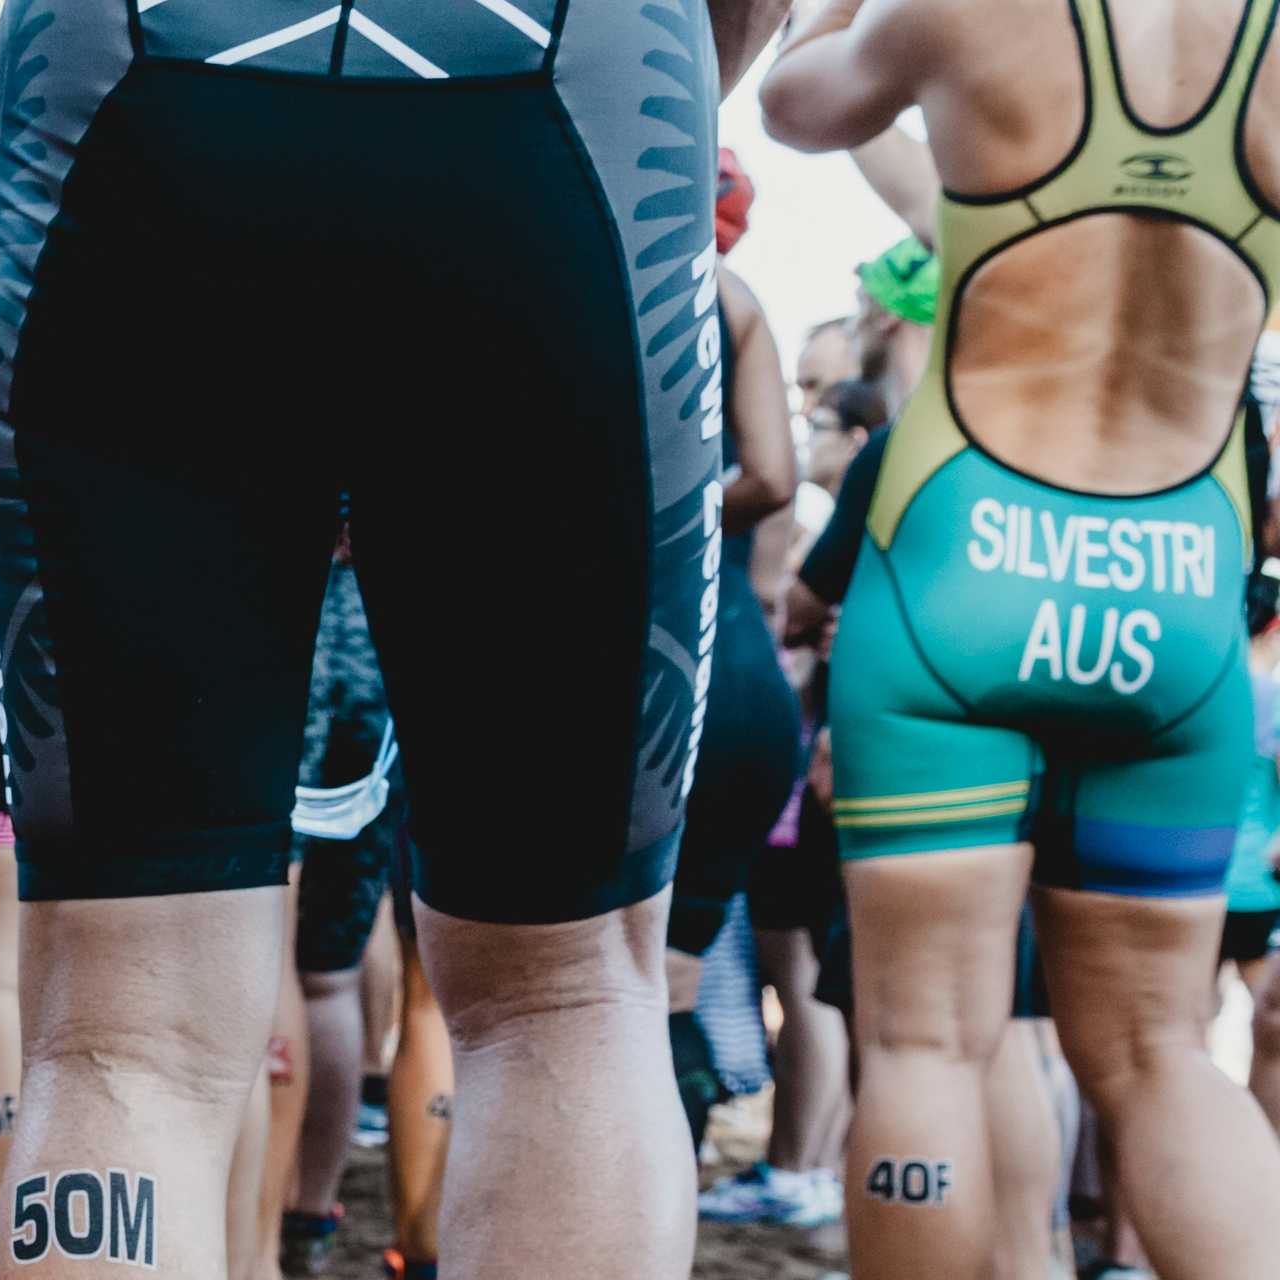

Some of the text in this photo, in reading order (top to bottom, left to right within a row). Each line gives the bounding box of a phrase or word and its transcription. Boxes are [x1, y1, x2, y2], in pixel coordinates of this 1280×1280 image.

[967, 497, 1215, 598] SILVESTRI
[1017, 598, 1162, 695] AUS
[12, 1170, 155, 1266] 50M
[866, 1160, 952, 1206] 40F
